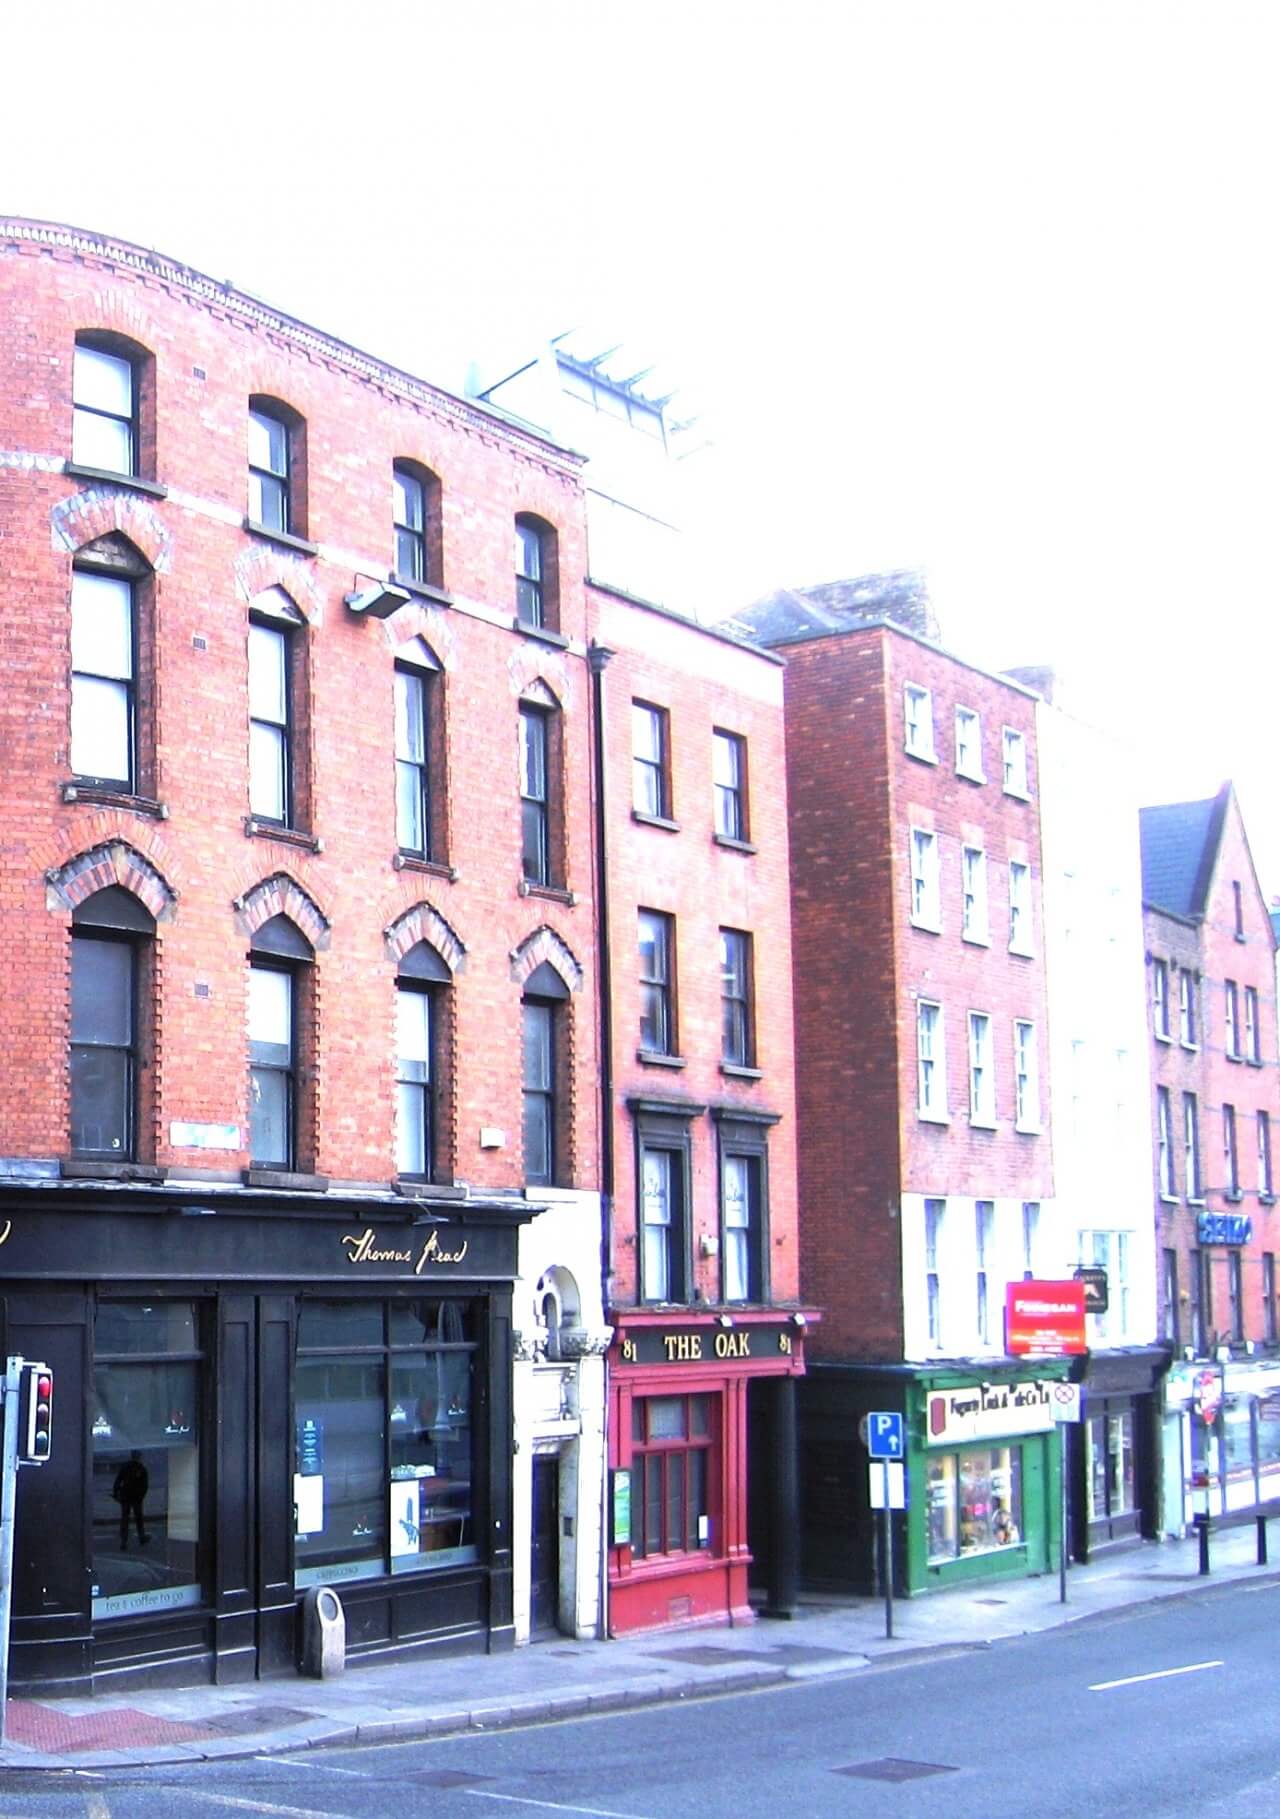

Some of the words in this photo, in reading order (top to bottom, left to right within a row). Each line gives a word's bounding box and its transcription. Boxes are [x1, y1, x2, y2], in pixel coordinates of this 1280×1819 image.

[342, 1228, 412, 1262] Thomas
[415, 1230, 468, 1275] Read
[623, 1339, 637, 1362] 81
[664, 1335, 702, 1360] THE
[715, 1332, 751, 1358] OAK
[778, 1333, 791, 1354] 81
[878, 1415, 892, 1435] P
